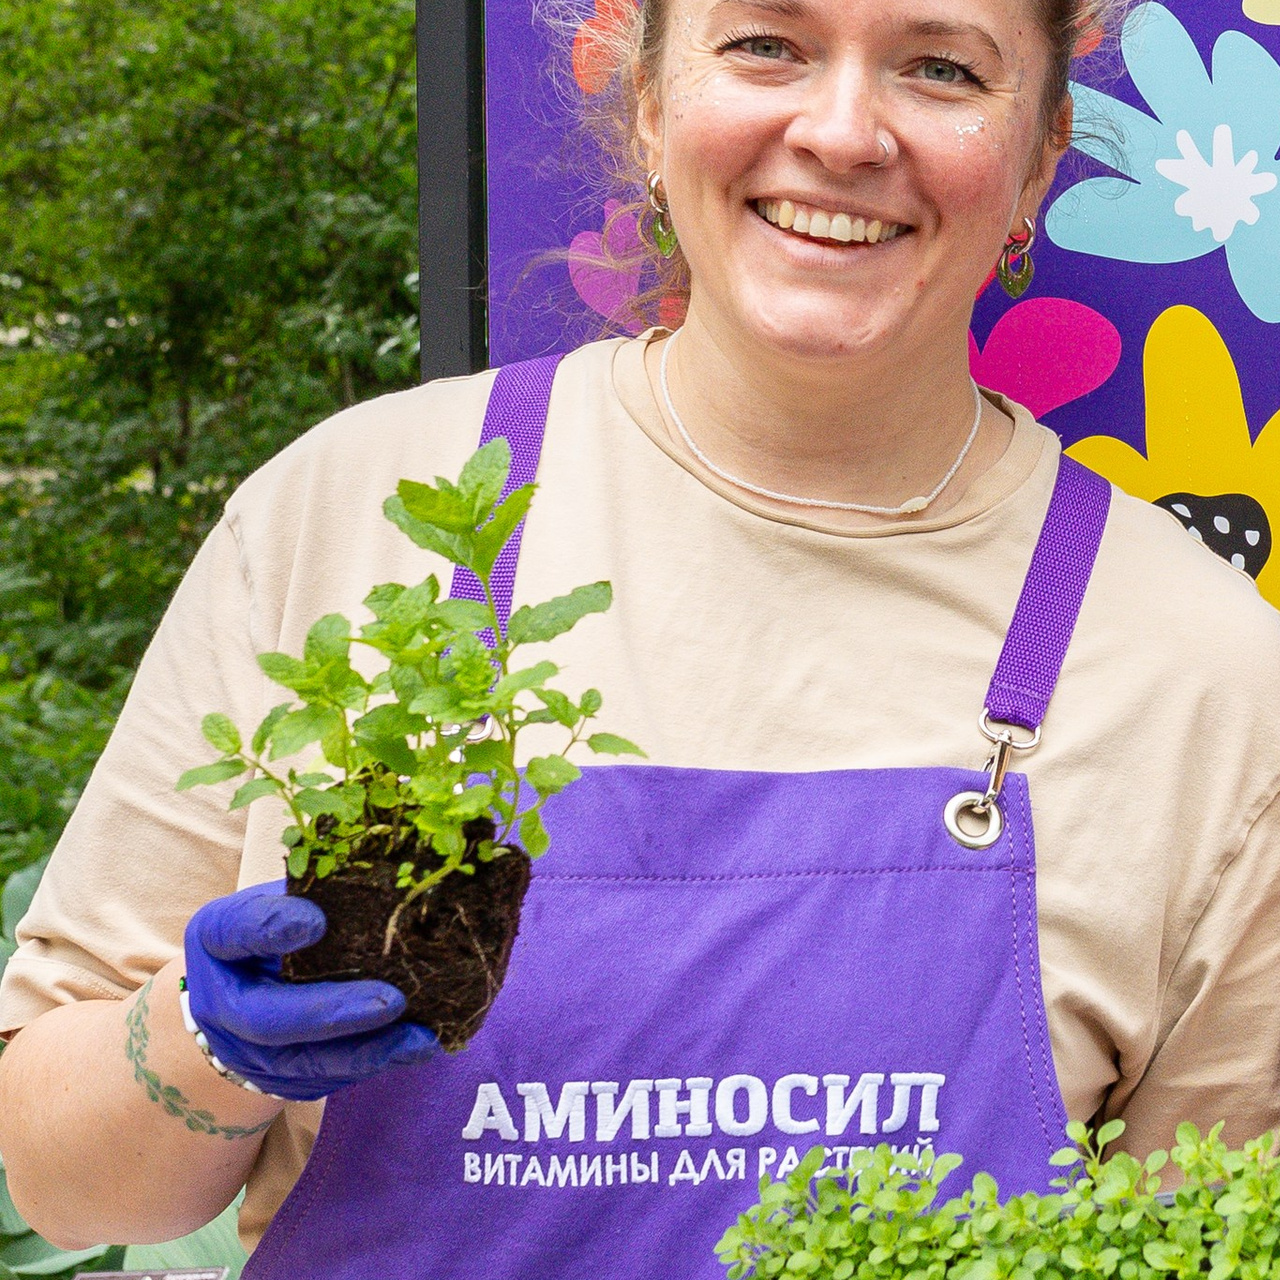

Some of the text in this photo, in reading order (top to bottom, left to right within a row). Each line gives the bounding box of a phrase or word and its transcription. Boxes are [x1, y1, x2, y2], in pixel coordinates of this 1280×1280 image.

[461, 1073, 946, 1143] АМИНОСИЛ
[463, 1150, 659, 1188] ВИТАМИНЫ
[668, 1148, 746, 1187] ДЛЯ
